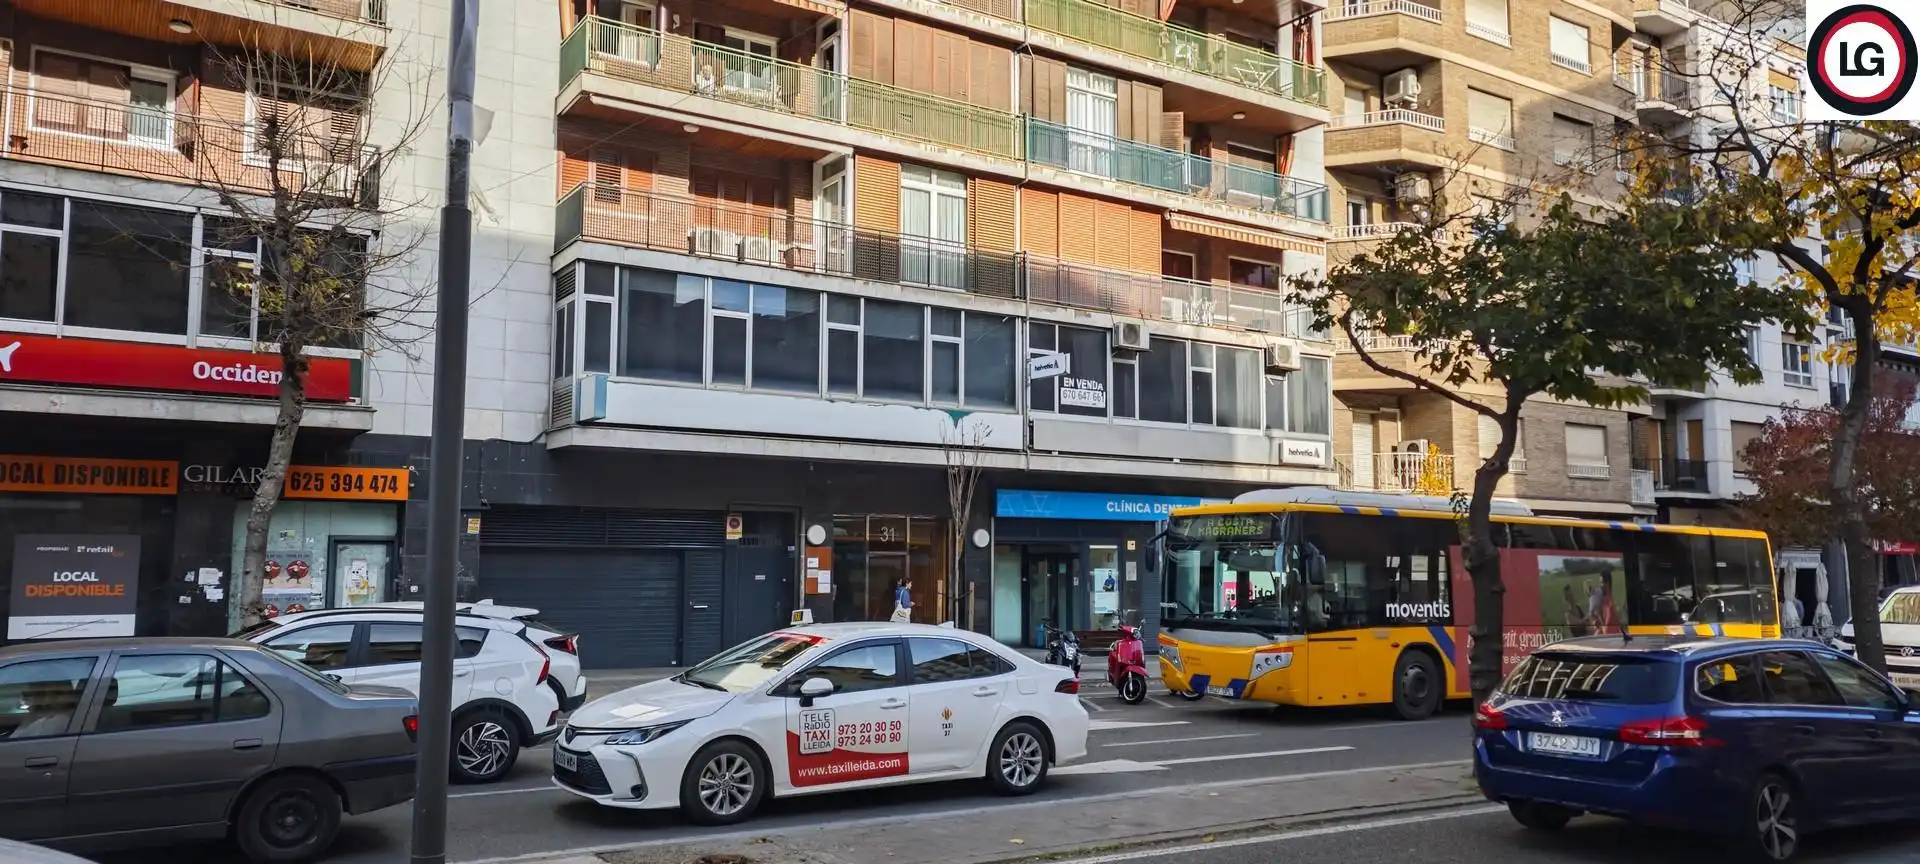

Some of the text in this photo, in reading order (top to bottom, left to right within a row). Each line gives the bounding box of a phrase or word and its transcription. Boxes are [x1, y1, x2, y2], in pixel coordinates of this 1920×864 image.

[193, 361, 284, 384] Occiden
[1034, 363, 1053, 371] helvetia
[1063, 377, 1104, 390] EN VENDA
[1063, 389, 1076, 400] 670
[1077, 390, 1090, 400] 647
[1288, 447, 1313, 456] helvetia
[55, 464, 170, 488] DISPONIBLE
[290, 472, 398, 493] 625 394 474
[1106, 500, 1193, 514] CLÍNICA DEN
[880, 526, 895, 542] 31
[1198, 525, 1264, 536] MAGRANERS
[86, 545, 114, 553] retail
[53, 571, 99, 582] LOCAL
[25, 584, 125, 597] DISPONIBLE
[1385, 600, 1451, 618] moventis
[1519, 631, 1543, 652] gran
[1543, 629, 1563, 646] vida
[803, 712, 830, 722] TELE
[838, 720, 901, 736] 973 20 30 50
[804, 730, 830, 742] TAXI
[838, 732, 901, 747] 973 24 90 90
[803, 740, 831, 750] LLEIDA
[1536, 734, 1597, 753] 3742 JJY
[798, 758, 901, 777] www.taxilleida.com
